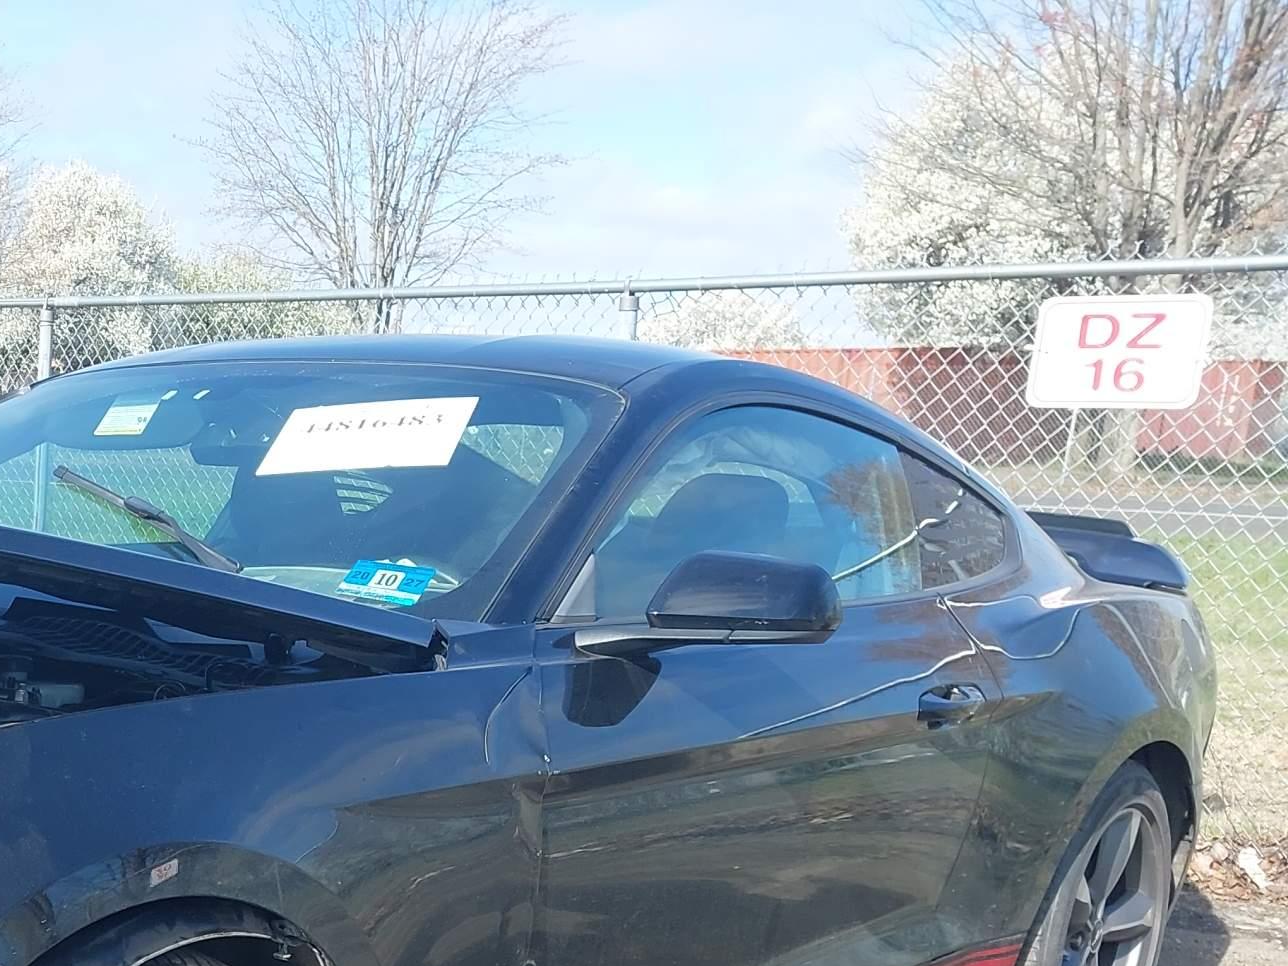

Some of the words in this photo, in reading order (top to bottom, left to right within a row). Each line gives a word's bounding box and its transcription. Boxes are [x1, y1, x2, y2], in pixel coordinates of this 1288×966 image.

[1078, 313, 1167, 349] DZ
[1085, 358, 1145, 392] 16
[352, 570, 370, 580] 20
[374, 573, 398, 586] 10
[404, 579, 425, 588] 27
